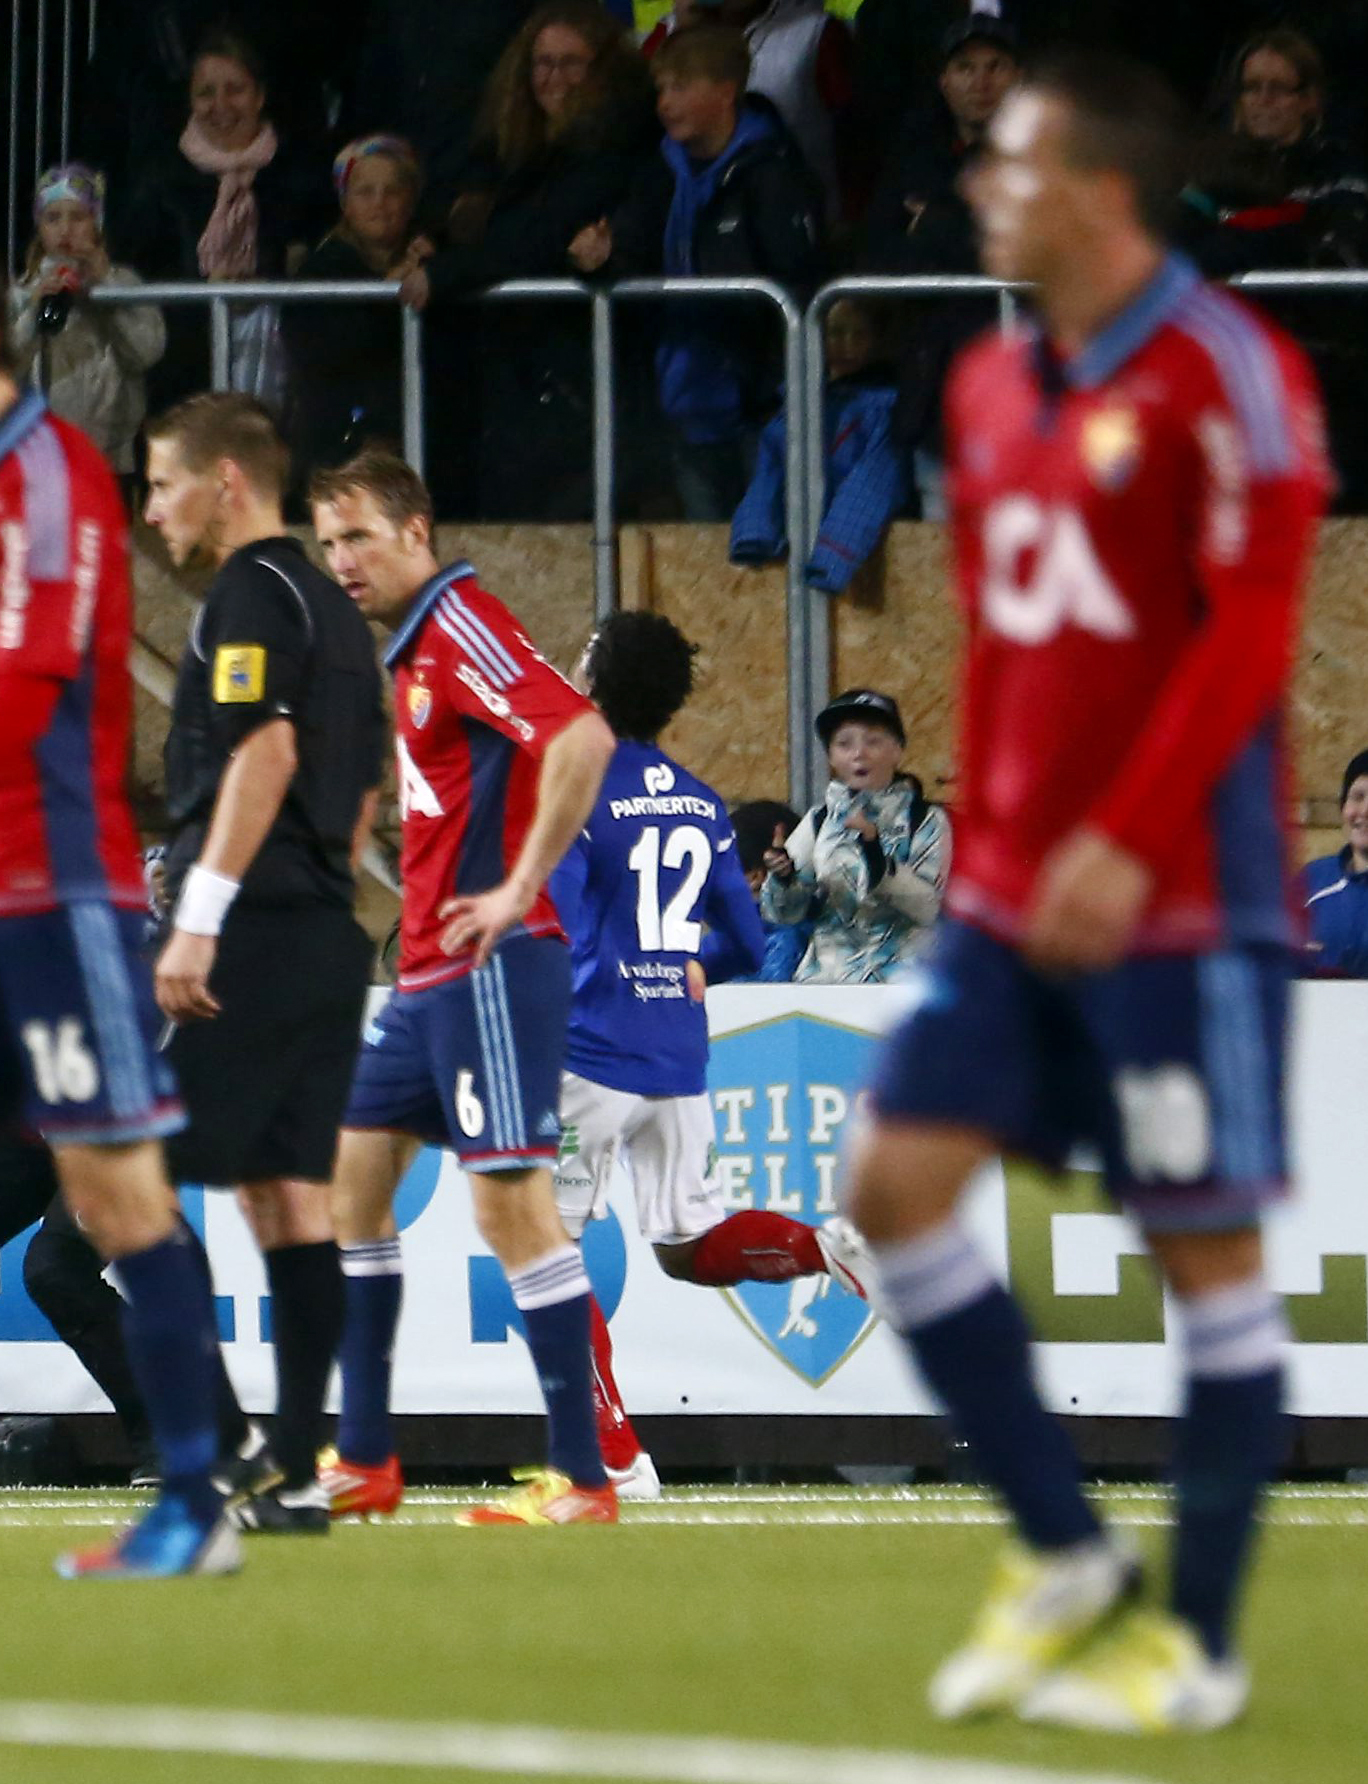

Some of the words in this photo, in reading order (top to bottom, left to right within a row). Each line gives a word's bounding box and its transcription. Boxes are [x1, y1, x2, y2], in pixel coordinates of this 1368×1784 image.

[629, 825, 712, 953] 12
[21, 1018, 98, 1104] 16
[455, 1068, 485, 1138] 6
